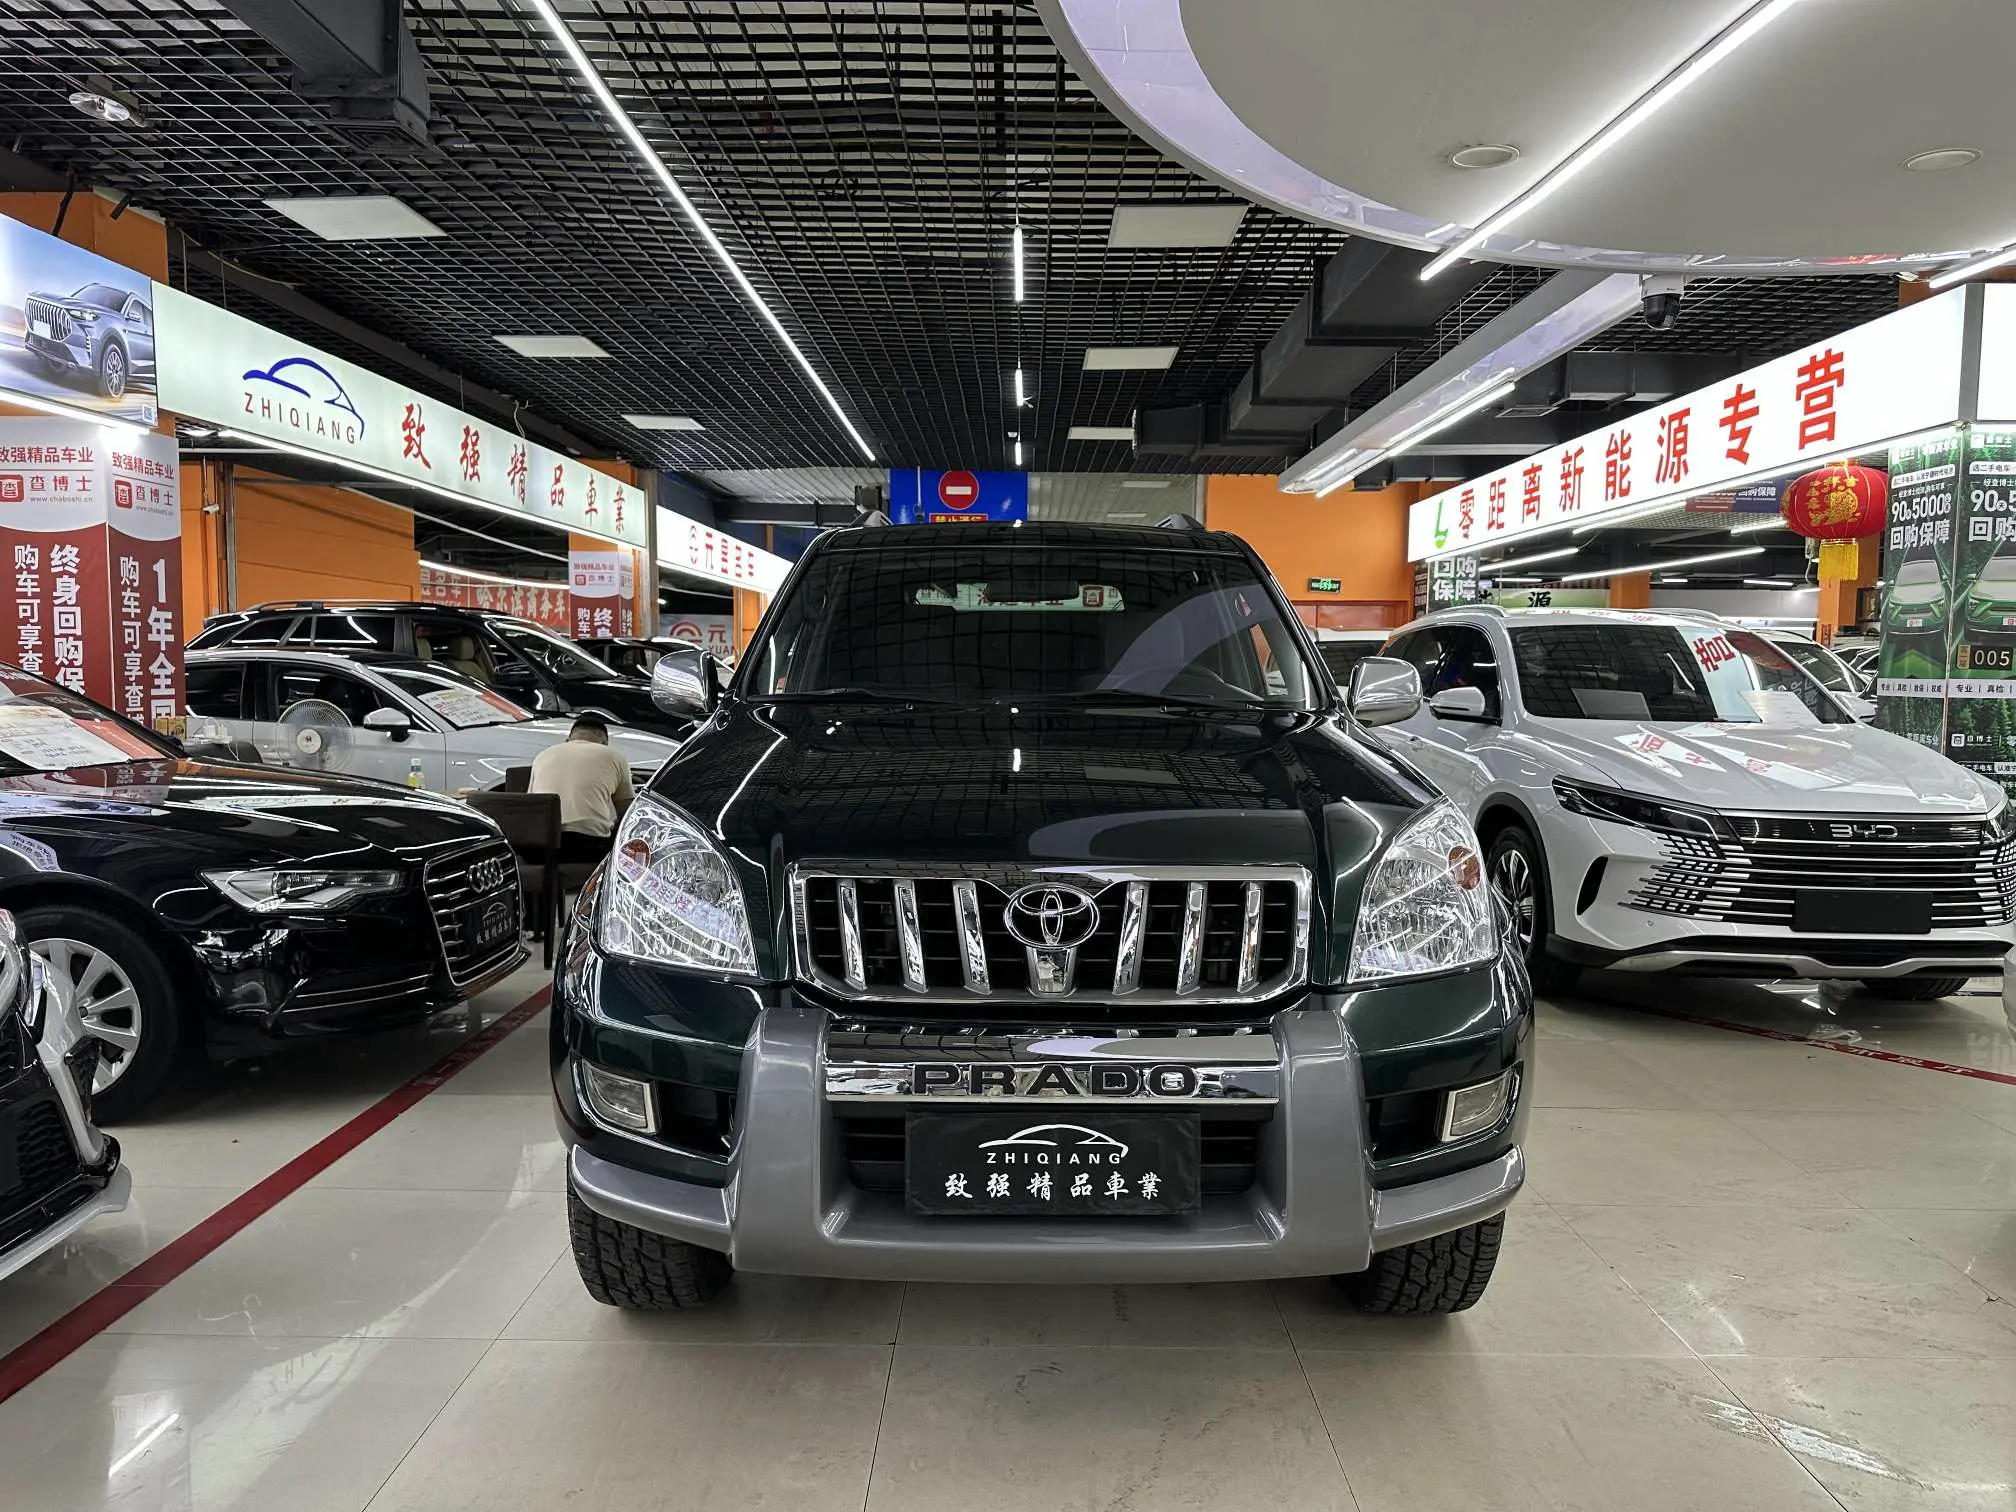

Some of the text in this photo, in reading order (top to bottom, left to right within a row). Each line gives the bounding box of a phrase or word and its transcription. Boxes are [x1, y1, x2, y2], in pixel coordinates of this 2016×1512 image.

[244, 391, 356, 445] ZHIQIANG
[0, 446, 94, 464] 致强精品车业
[1458, 348, 1845, 540] 零距离新能源专营
[112, 451, 174, 480] 致强精品车业
[402, 403, 626, 535] 致强精品車業
[30, 475, 92, 492] 查博士
[135, 485, 174, 506] 查博士
[1890, 519, 1951, 551] 回购保障
[1434, 557, 1477, 578] 回购
[1433, 579, 1477, 601] 保障
[50, 543, 86, 695] 终身回购保
[577, 607, 591, 639] 购车
[1974, 649, 2010, 667] 005
[1956, 684, 1973, 693] 专业
[1829, 824, 1899, 839] BYD
[912, 1063, 1199, 1097] PRADO
[986, 1152, 1121, 1165] ZHIQIANG
[944, 1171, 1162, 1201] 致强精品車業
